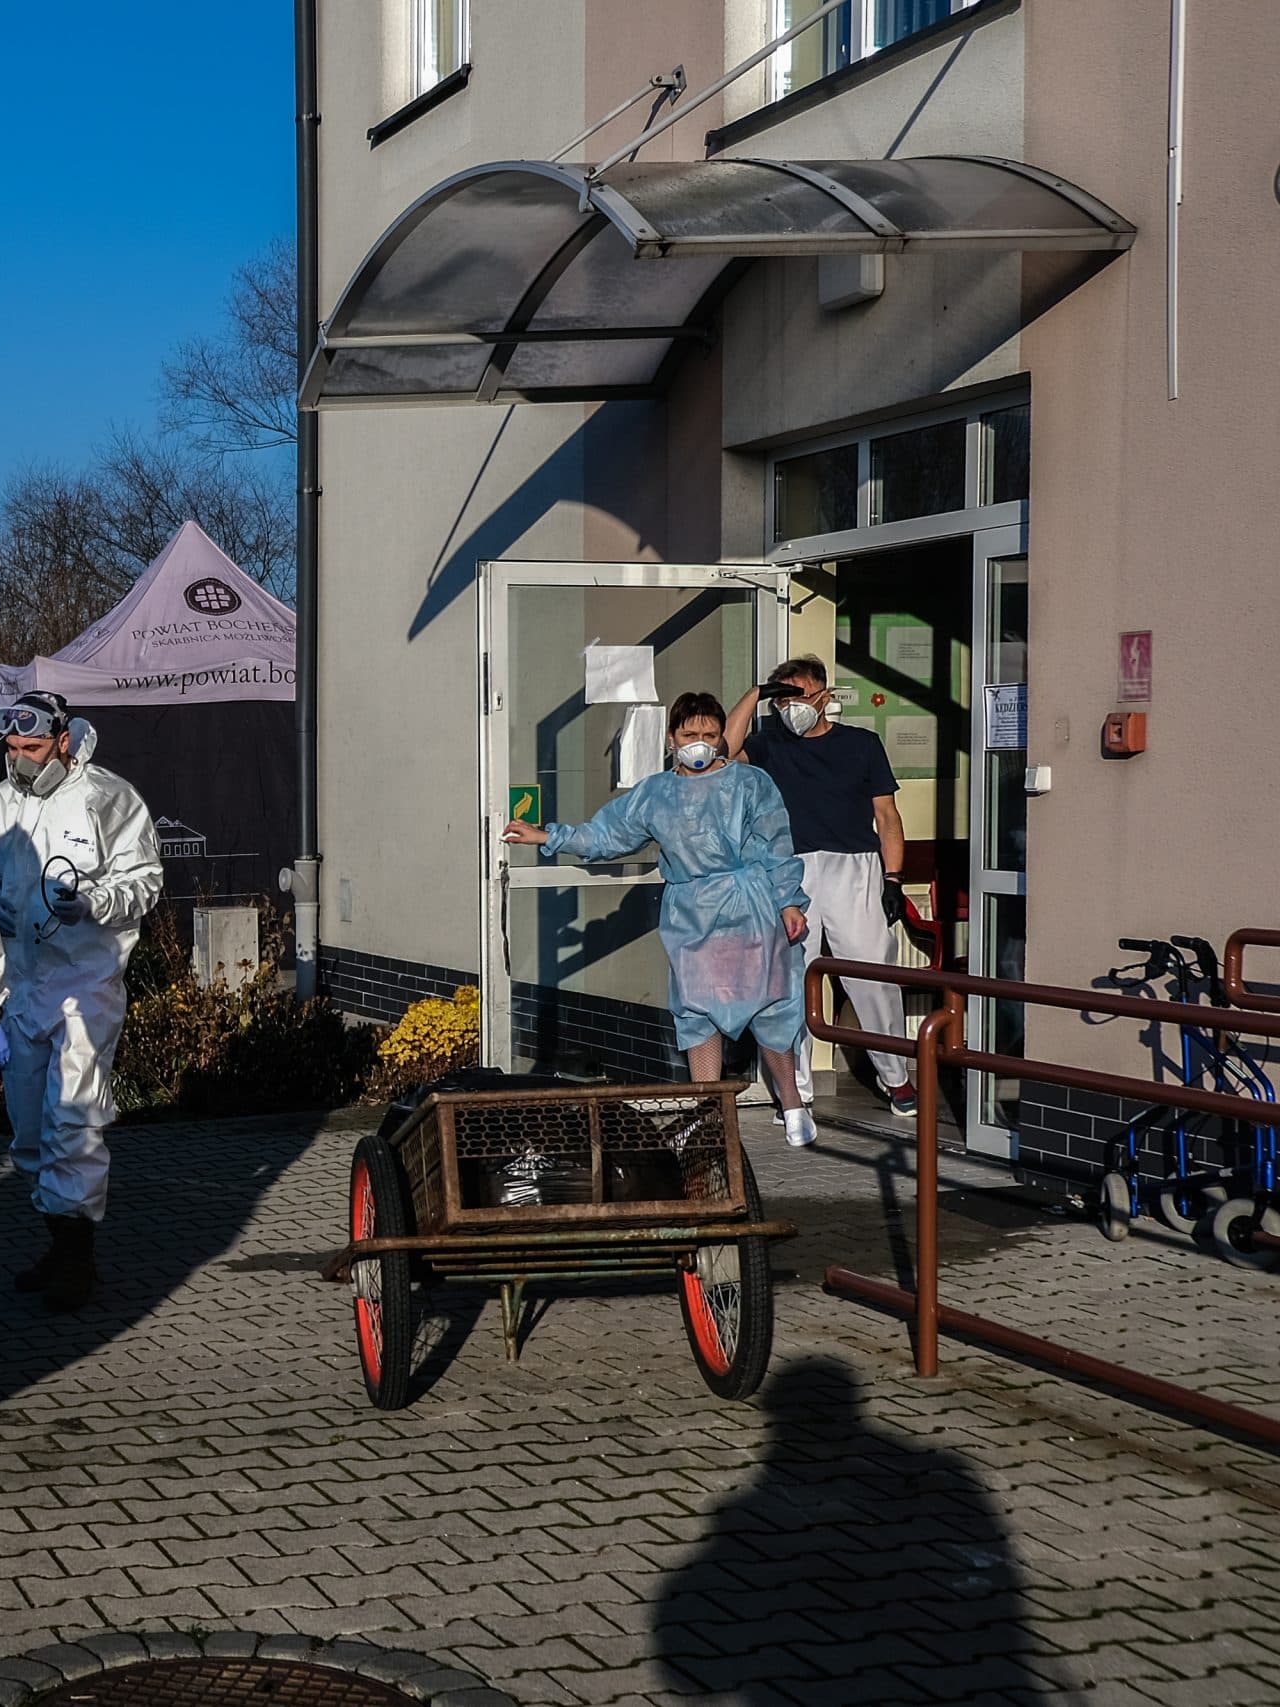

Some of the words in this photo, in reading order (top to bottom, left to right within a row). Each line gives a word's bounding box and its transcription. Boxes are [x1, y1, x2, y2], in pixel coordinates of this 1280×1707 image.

[132, 621, 202, 640] POWIAT
[151, 634, 221, 648] SKARBNICA
[112, 662, 296, 695] www.powiat.bo
